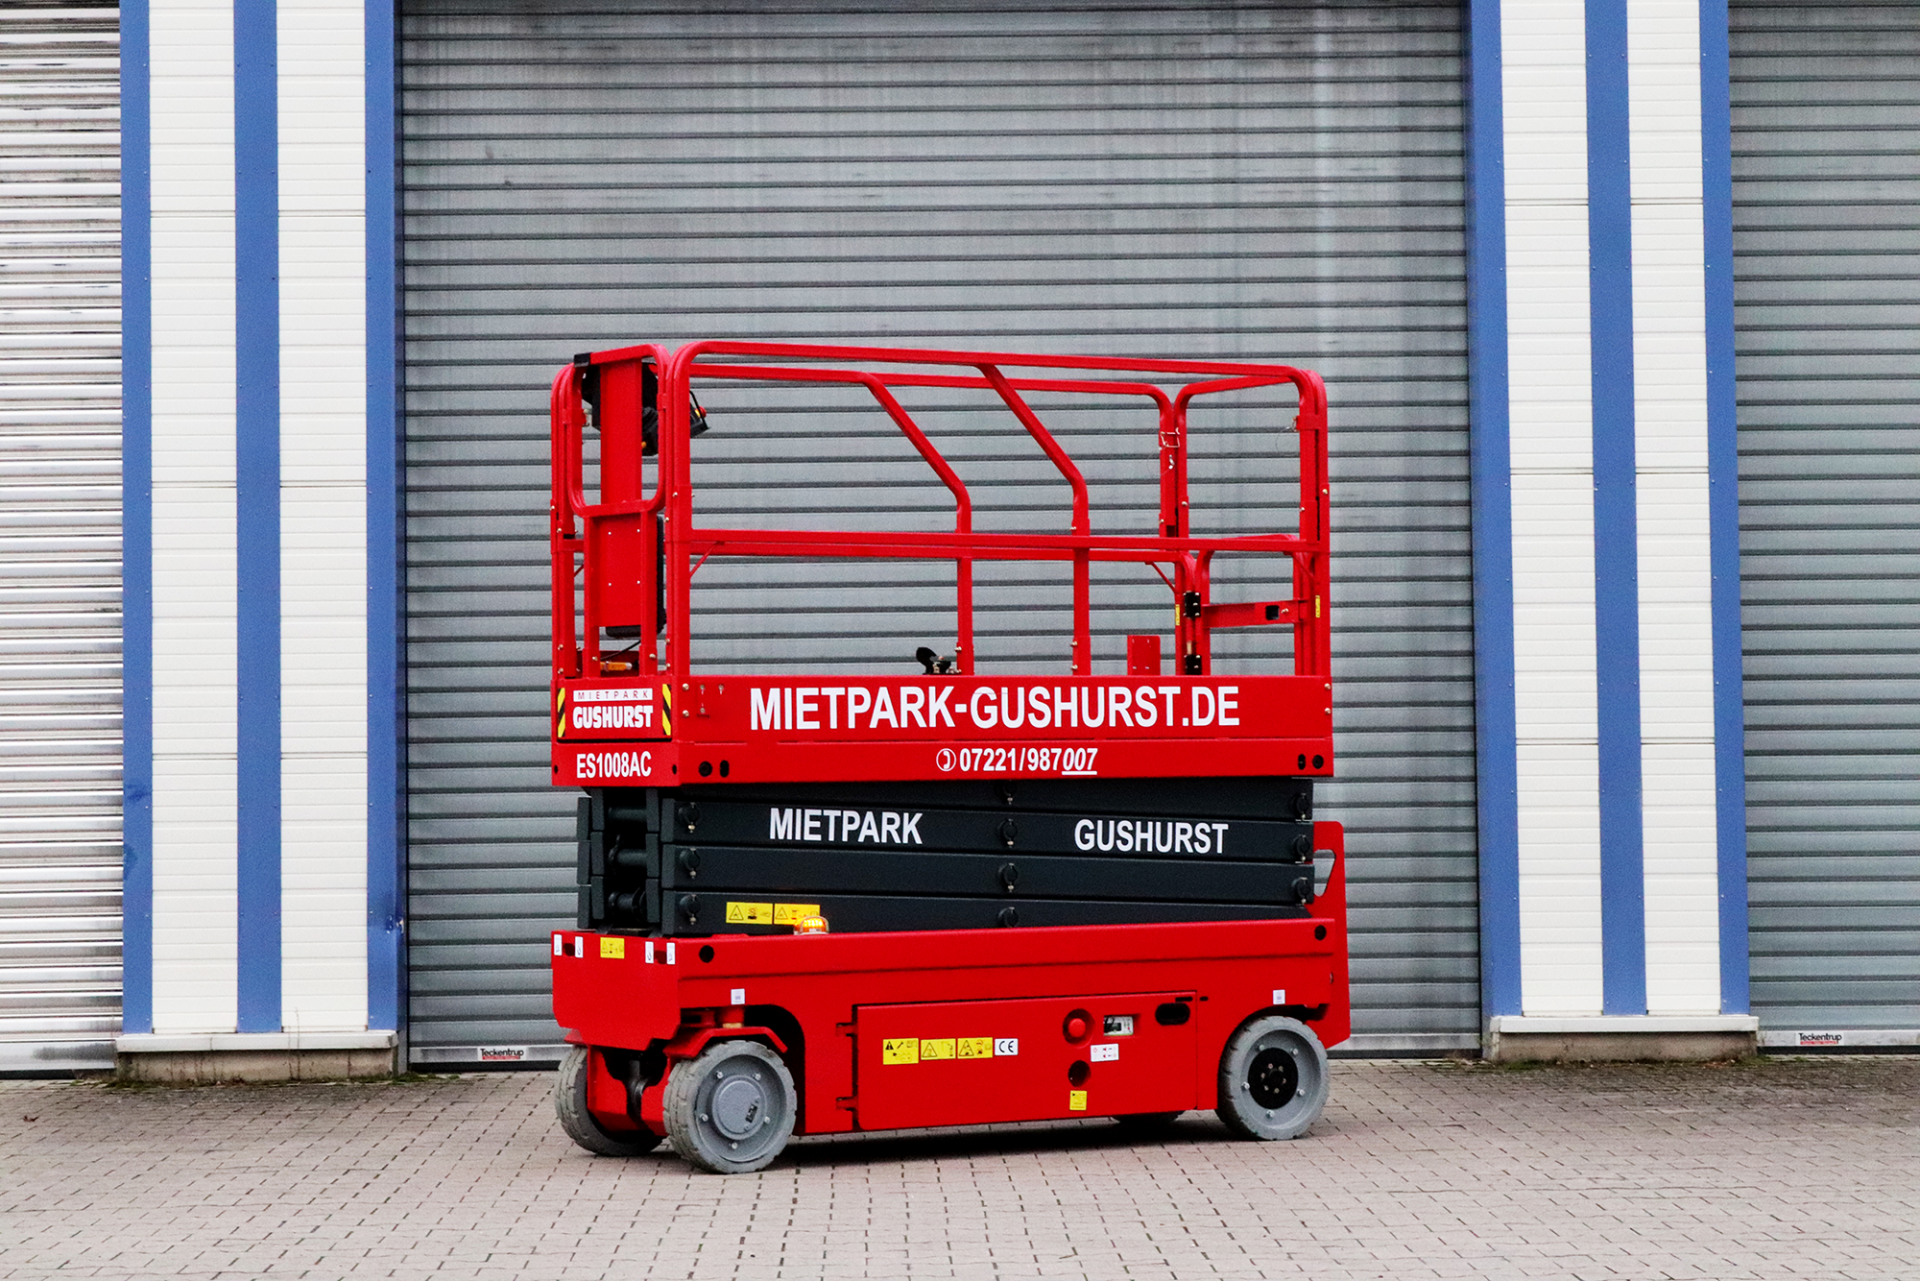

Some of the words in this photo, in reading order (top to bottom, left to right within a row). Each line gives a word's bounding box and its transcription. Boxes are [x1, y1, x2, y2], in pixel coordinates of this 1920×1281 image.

[578, 690, 649, 700] MIETPARK
[573, 705, 653, 729] GUSHURST
[750, 686, 1240, 730] MIETPARK-GUSHURST.DE
[576, 751, 652, 778] ES1008AC
[960, 748, 1098, 775] 07221/987007
[769, 808, 923, 844] MIETPARK
[1074, 819, 1229, 853] GUSHURST
[998, 1040, 1015, 1053] CE
[1798, 1032, 1843, 1044] Teckentrup
[480, 1048, 524, 1059] Teckentrup
